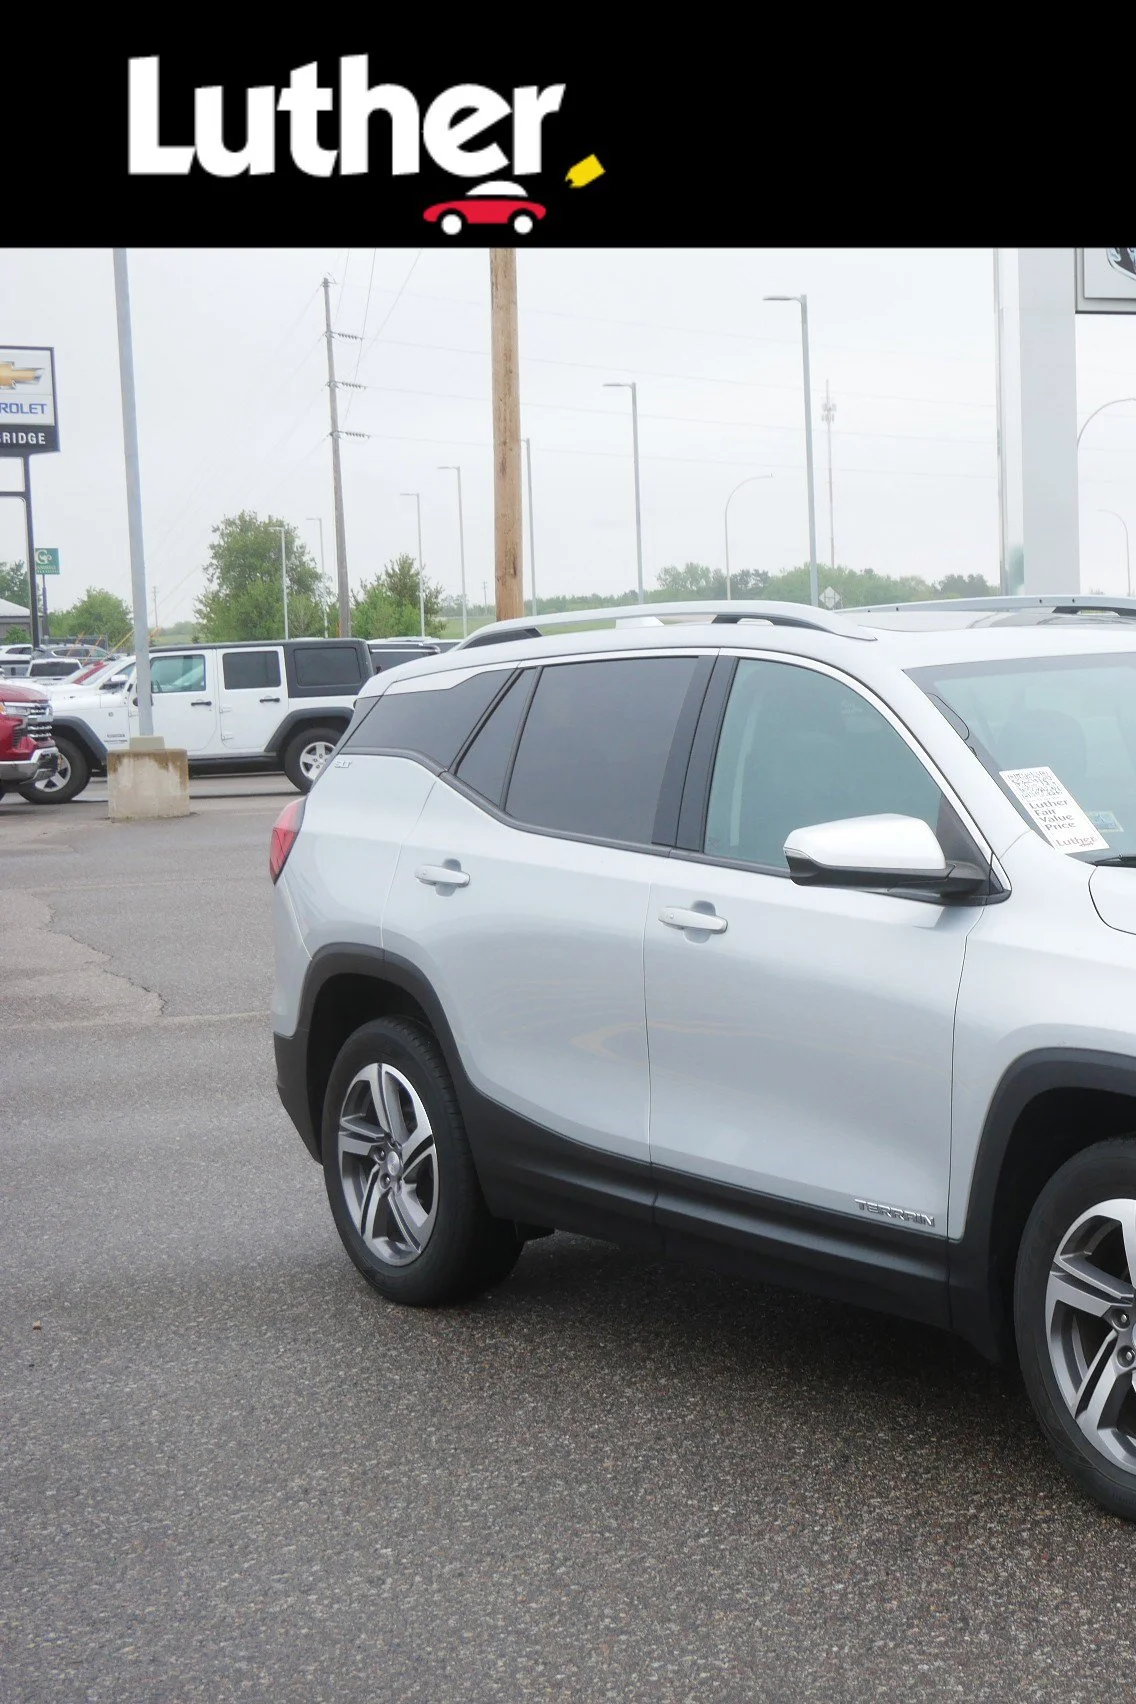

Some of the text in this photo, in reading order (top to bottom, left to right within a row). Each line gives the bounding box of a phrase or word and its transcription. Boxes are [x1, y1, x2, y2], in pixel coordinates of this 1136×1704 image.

[0, 432, 46, 444] RIDGE
[1029, 799, 1068, 810] Luther
[1034, 808, 1057, 817] Fair
[1039, 814, 1075, 824] Value
[1044, 821, 1077, 831] Price
[854, 1198, 936, 1228] TERRAIN
